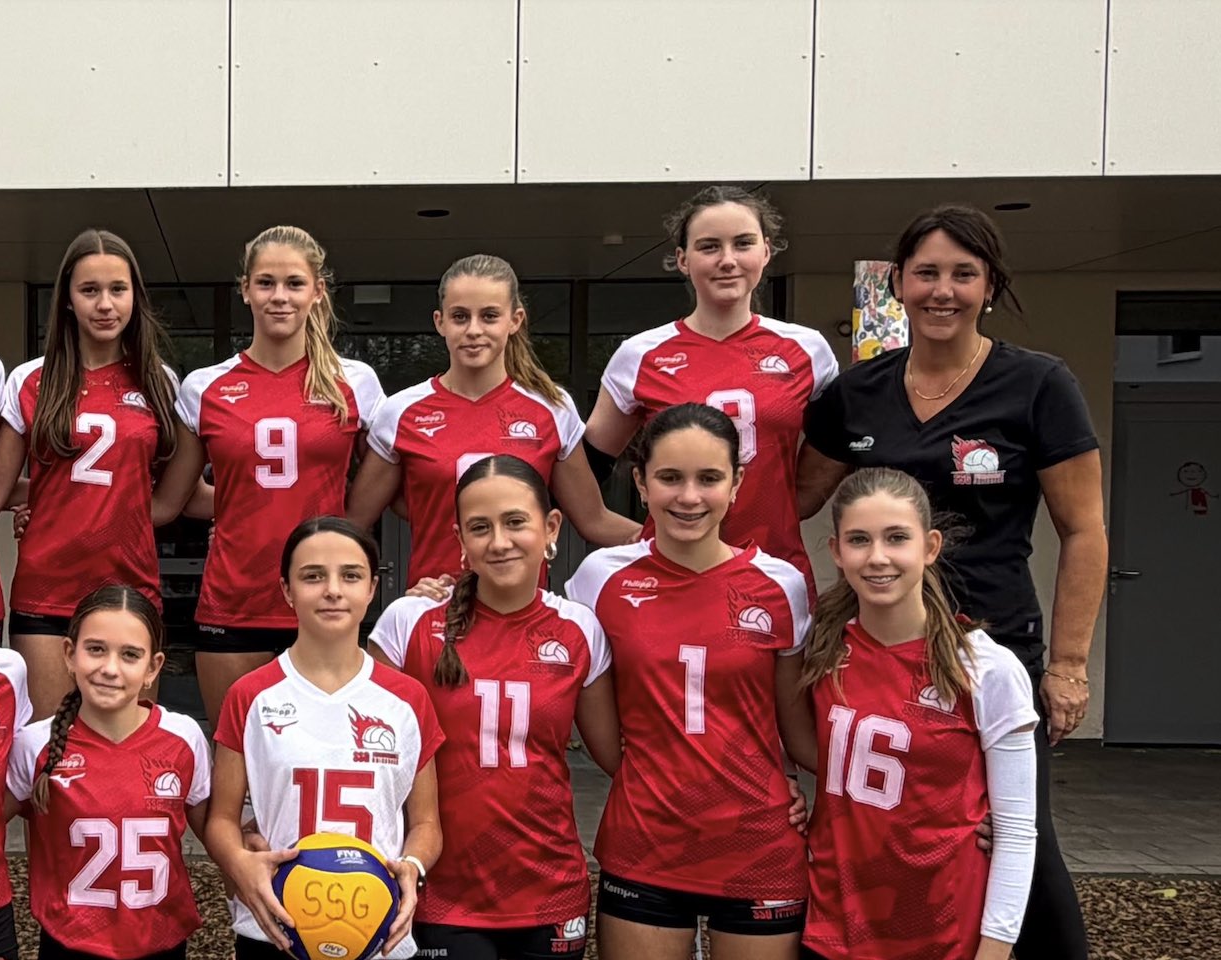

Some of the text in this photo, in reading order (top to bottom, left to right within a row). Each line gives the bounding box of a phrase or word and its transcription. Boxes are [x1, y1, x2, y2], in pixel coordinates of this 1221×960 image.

[70, 411, 117, 487] 2
[254, 417, 299, 489] 9
[474, 678, 531, 769] 11
[678, 644, 708, 735] 1
[825, 703, 912, 811] 16
[292, 767, 376, 846] 15
[66, 817, 171, 910] 25
[301, 880, 370, 921] SSG
[417, 947, 448, 959] empa
